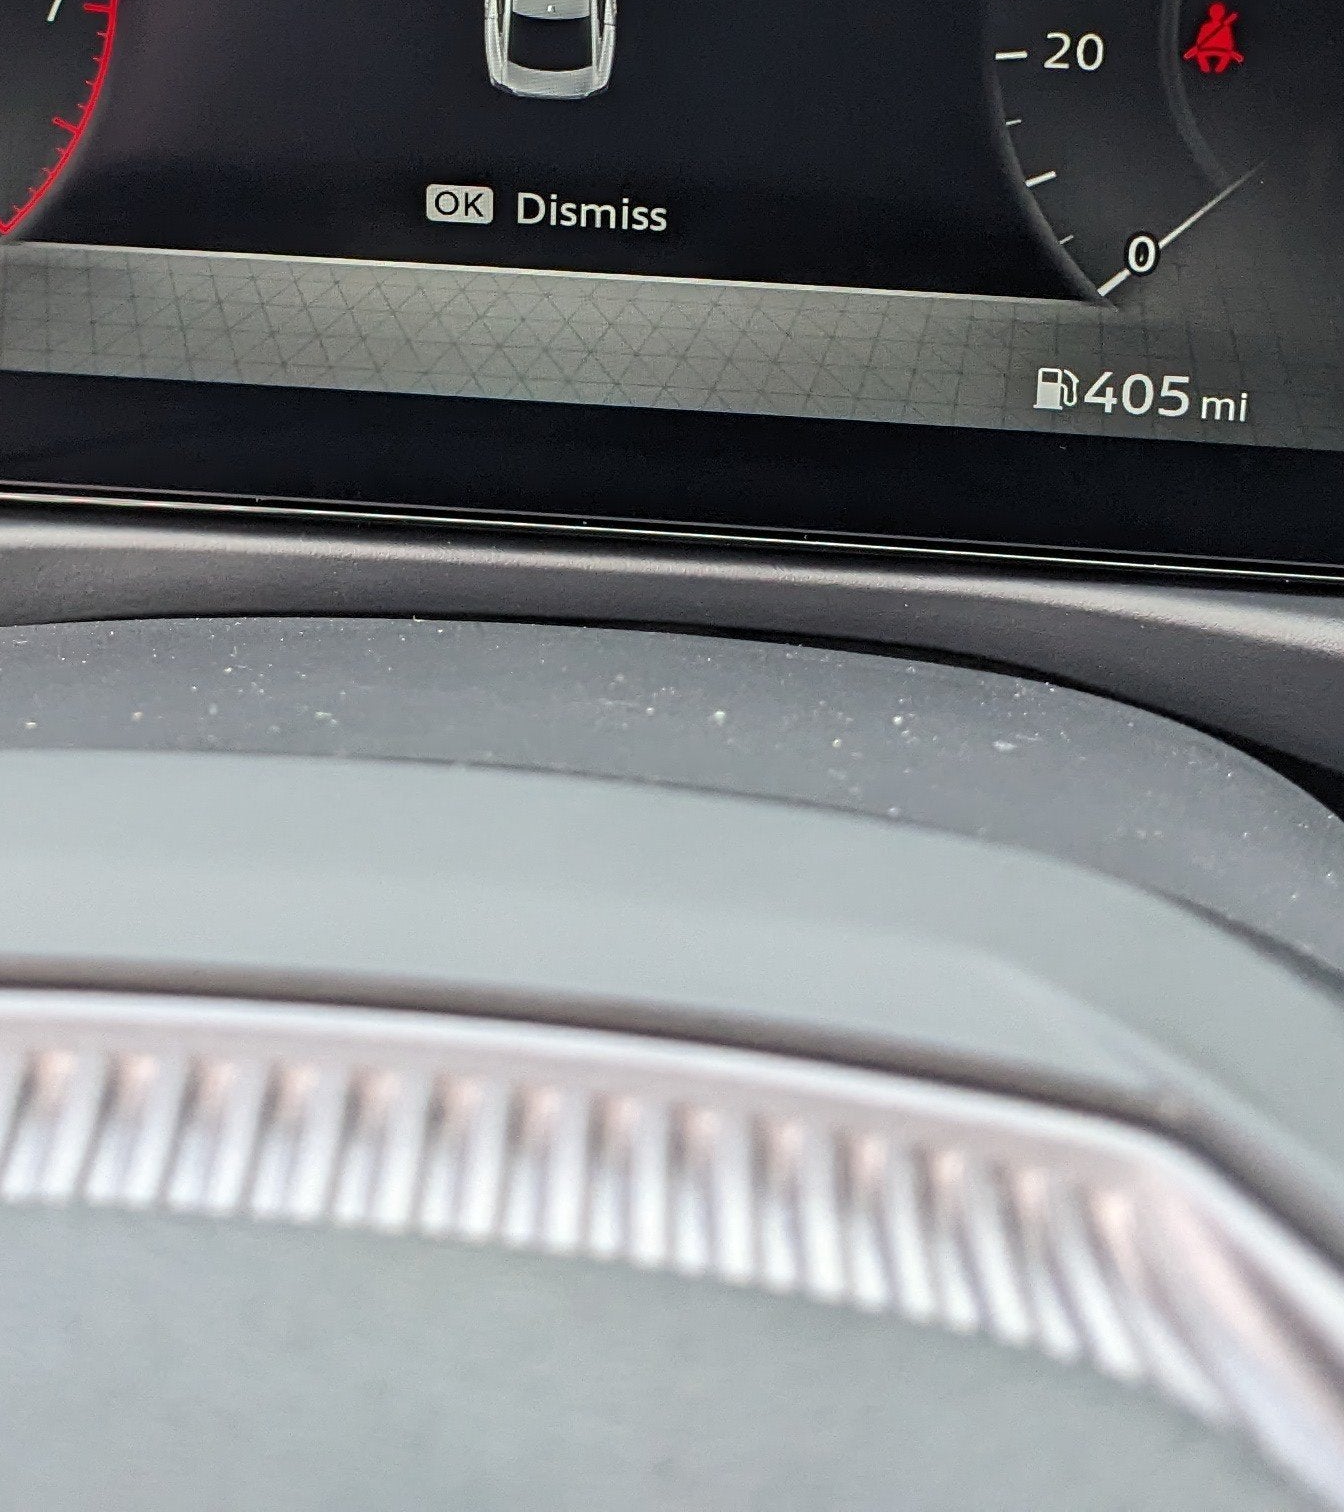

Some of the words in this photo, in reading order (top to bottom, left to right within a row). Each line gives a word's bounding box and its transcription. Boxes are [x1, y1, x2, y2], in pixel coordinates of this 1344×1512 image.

[1042, 34, 1106, 72] 20
[434, 190, 485, 218] OK
[517, 192, 668, 232] Dismiss
[1127, 236, 1158, 271] 0
[1083, 374, 1192, 418] 405
[1201, 392, 1250, 422] mi
